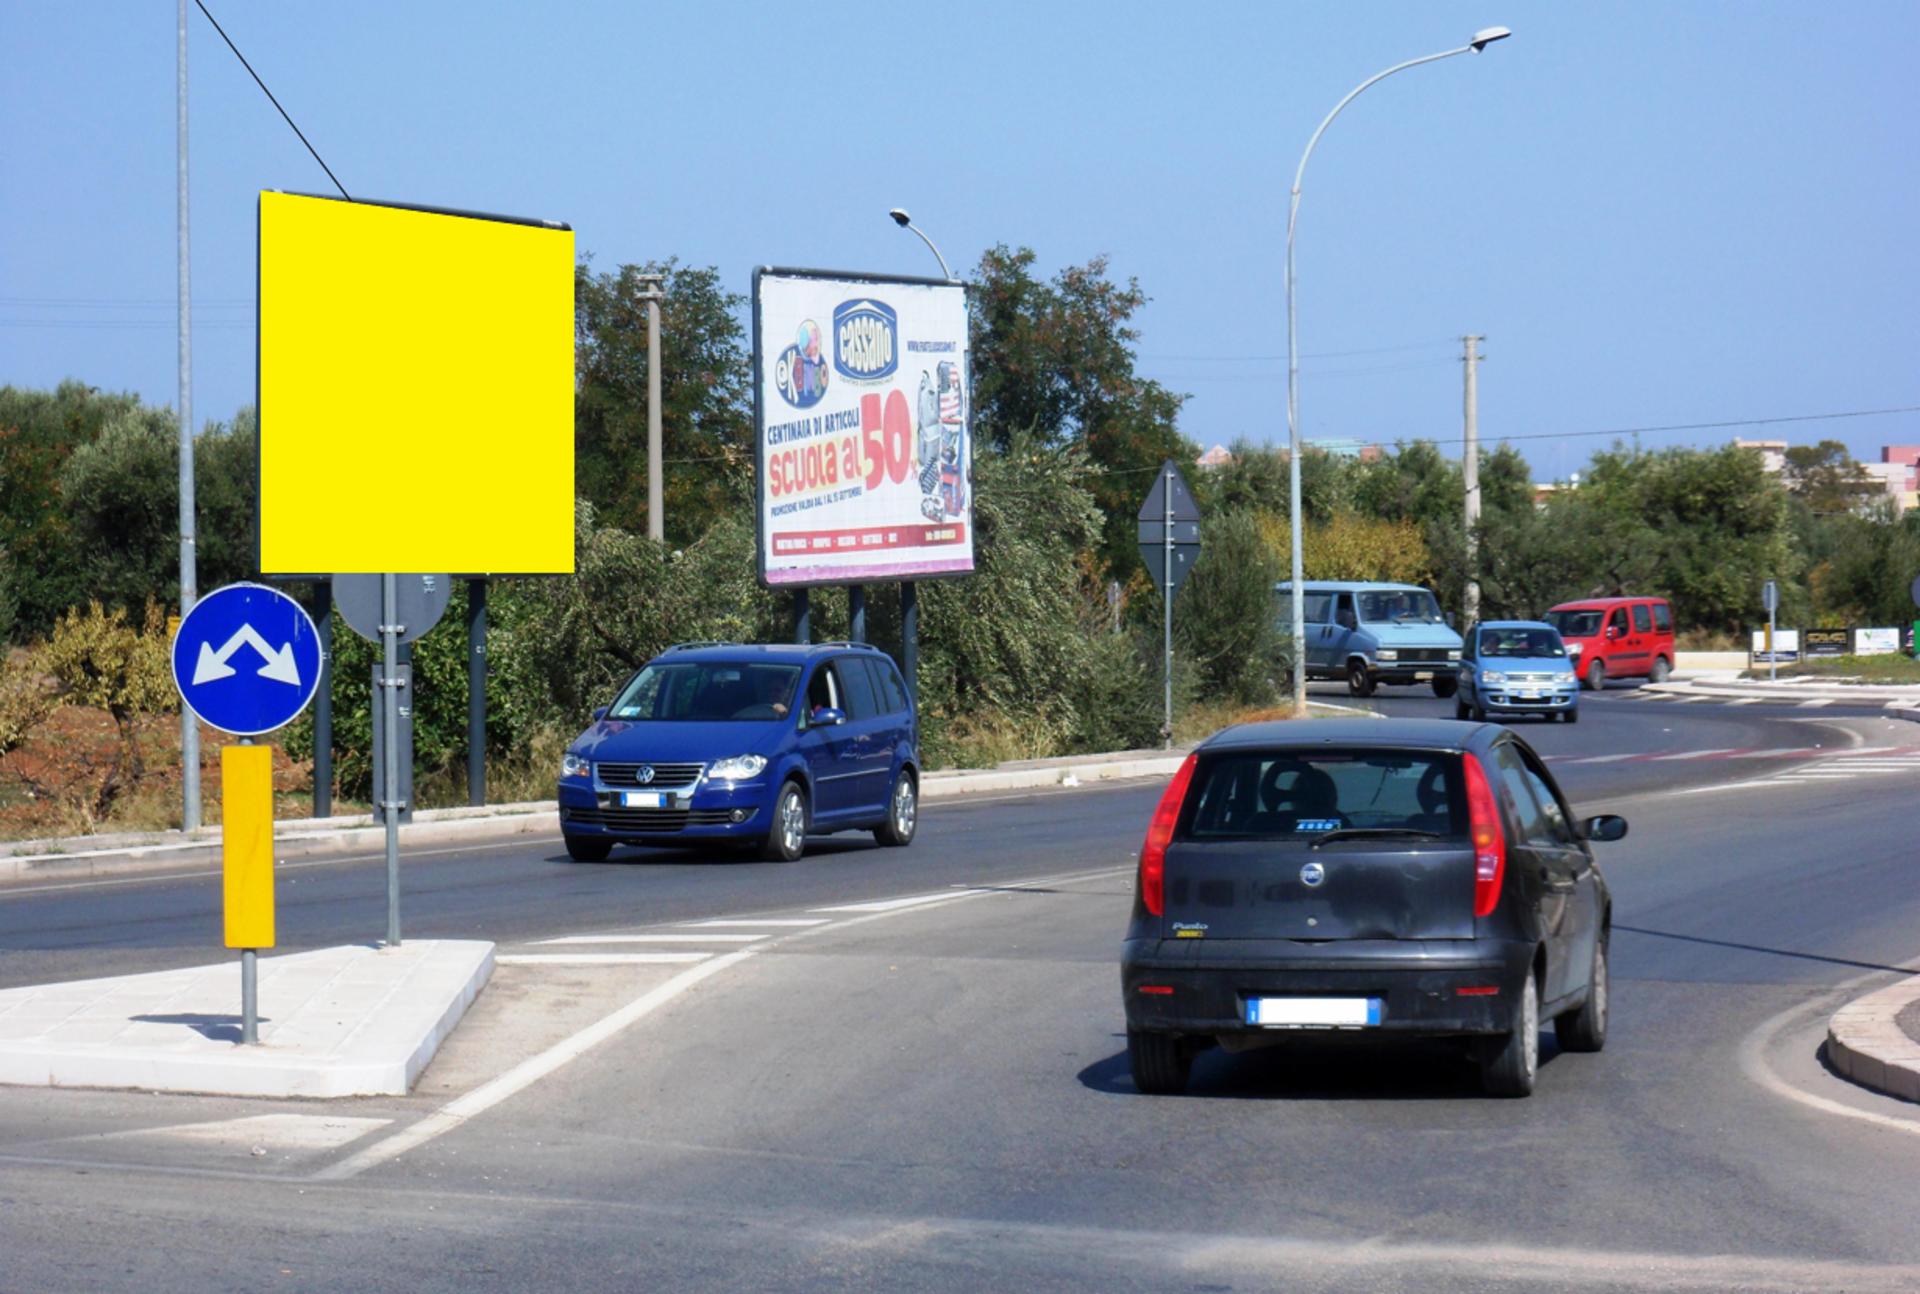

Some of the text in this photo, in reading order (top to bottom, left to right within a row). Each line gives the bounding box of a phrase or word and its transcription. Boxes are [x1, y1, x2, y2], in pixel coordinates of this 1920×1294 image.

[767, 407, 860, 446] CENTINAIA DI ARTICOLI
